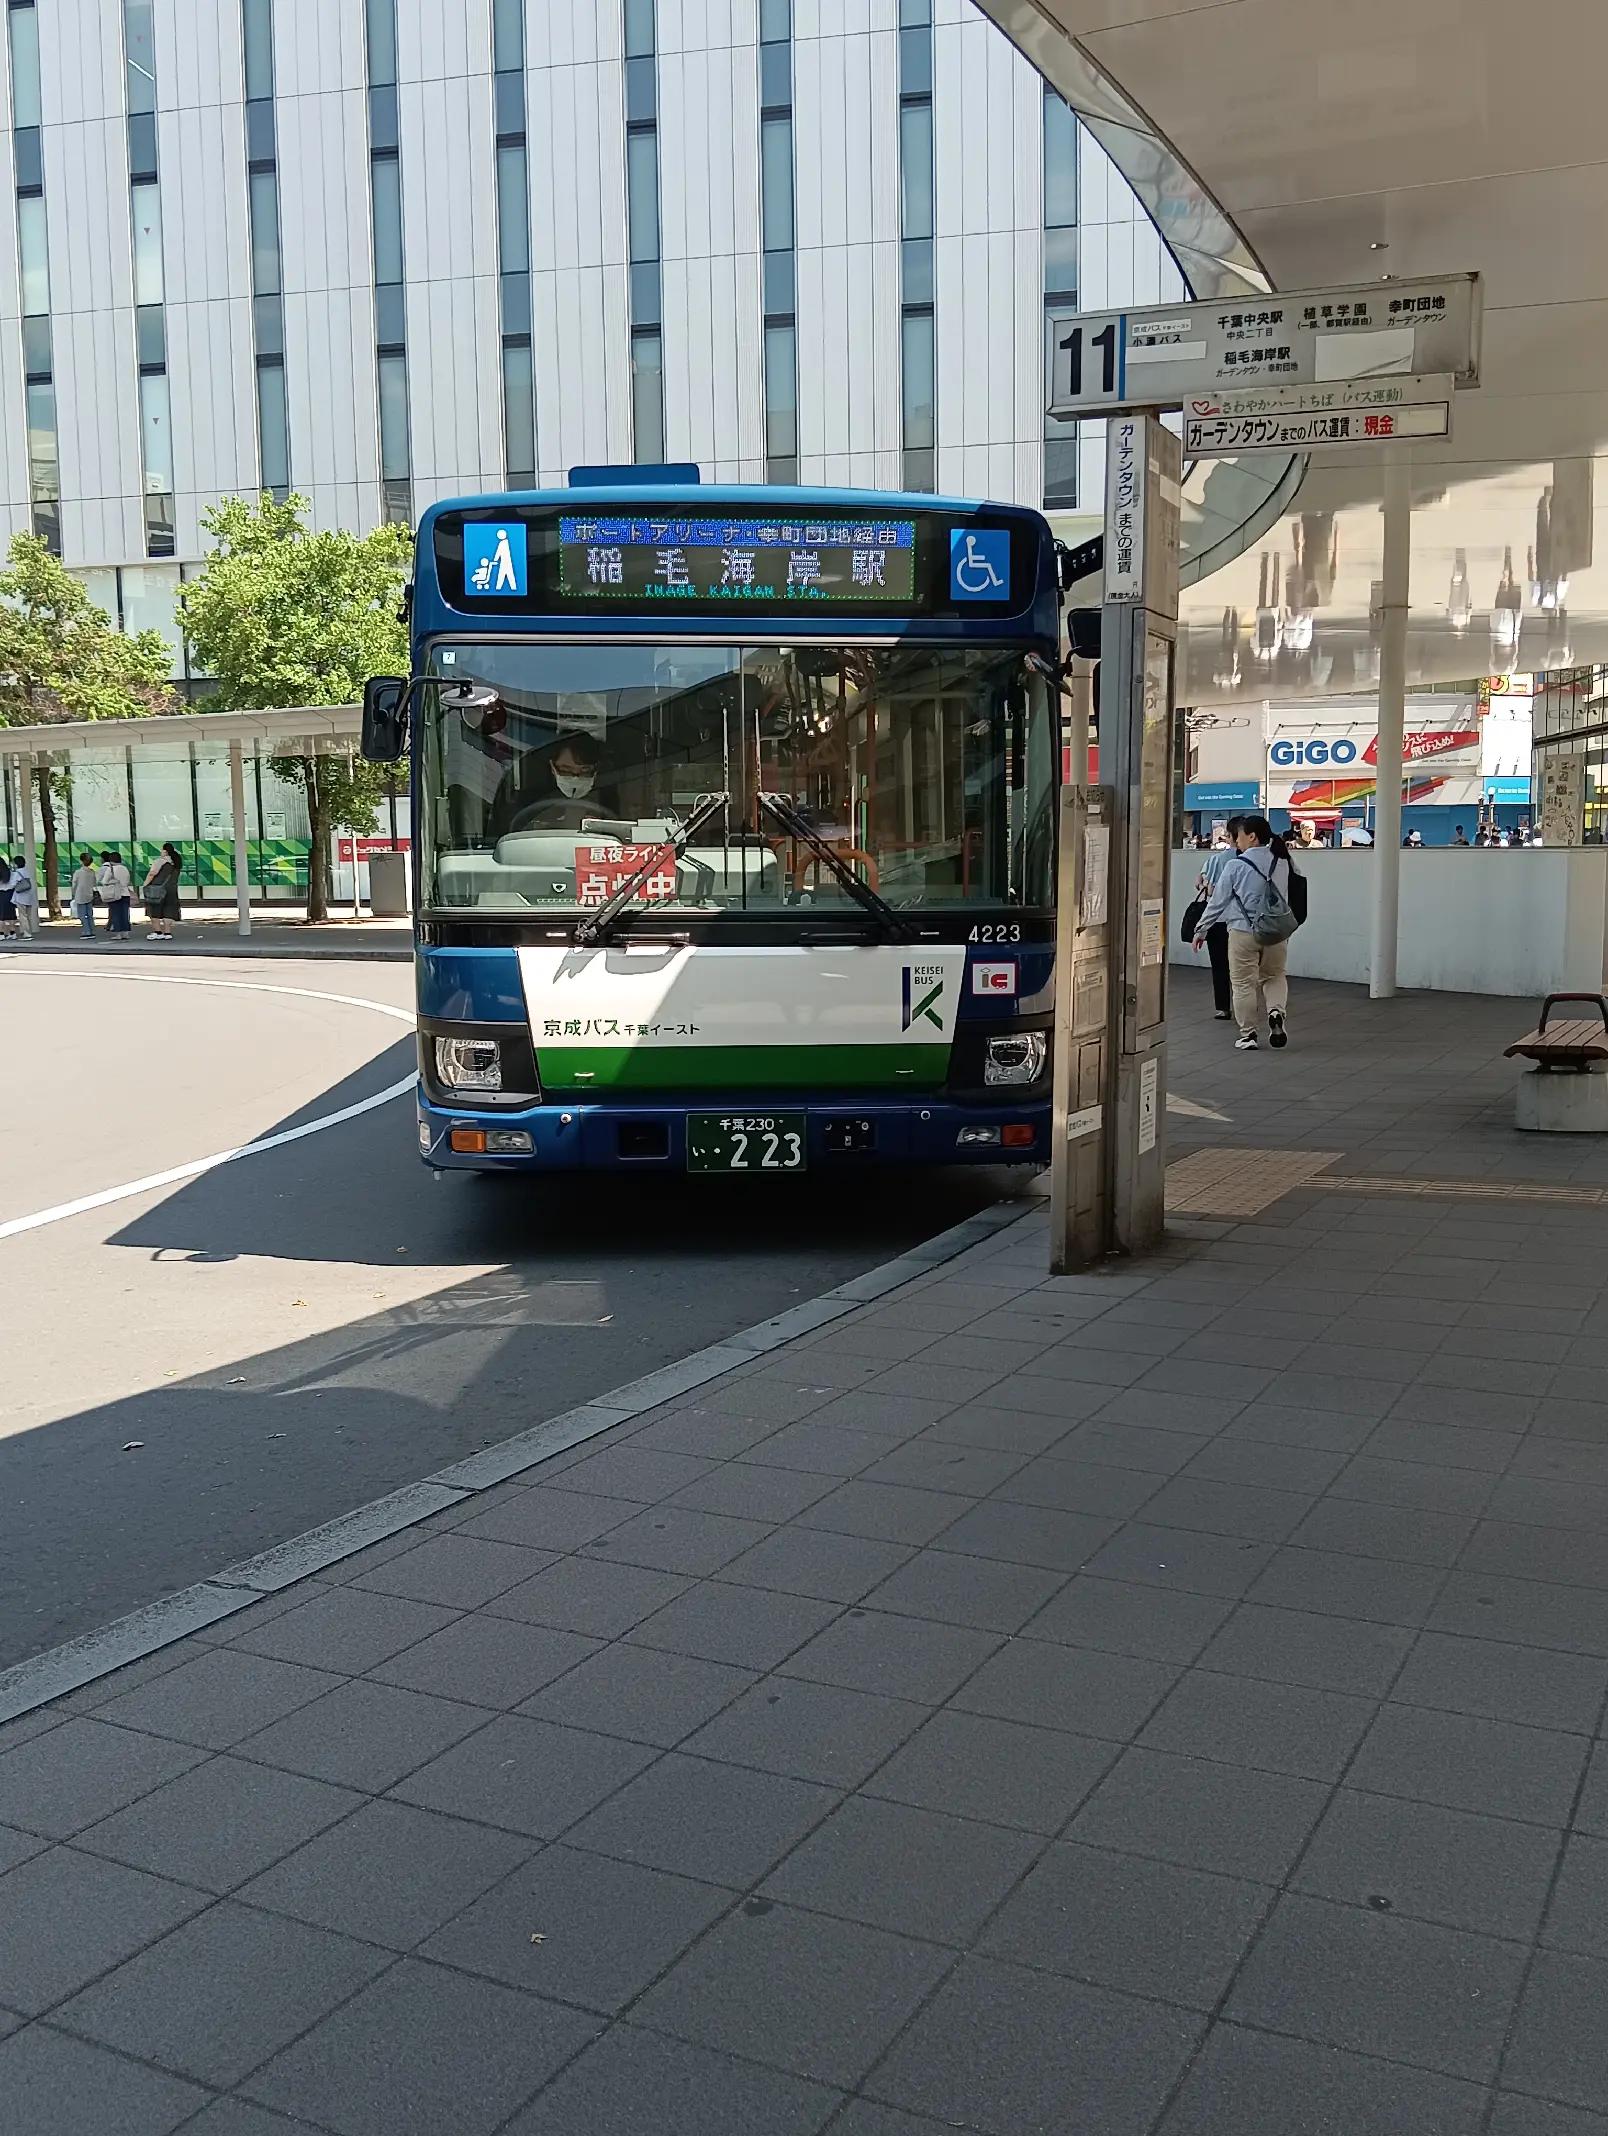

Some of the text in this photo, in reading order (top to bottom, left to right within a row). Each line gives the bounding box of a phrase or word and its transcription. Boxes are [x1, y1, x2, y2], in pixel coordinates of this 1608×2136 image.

[1303, 303, 1367, 320] 植草学園
[1389, 296, 1446, 313] 幸町団地
[1217, 310, 1284, 330] 千葉中央駅
[1387, 313, 1447, 327] ガーデンタウン
[1226, 327, 1273, 341] 中央二丁目
[1059, 324, 1116, 396] 11
[1224, 346, 1291, 365] 稲毛海岸駅
[586, 547, 886, 587] 稲毛海岸駅
[1270, 739, 1357, 766] GiGO
[968, 924, 1021, 943] 4223
[914, 966, 944, 975] KEISEI
[914, 976, 934, 985] BUS
